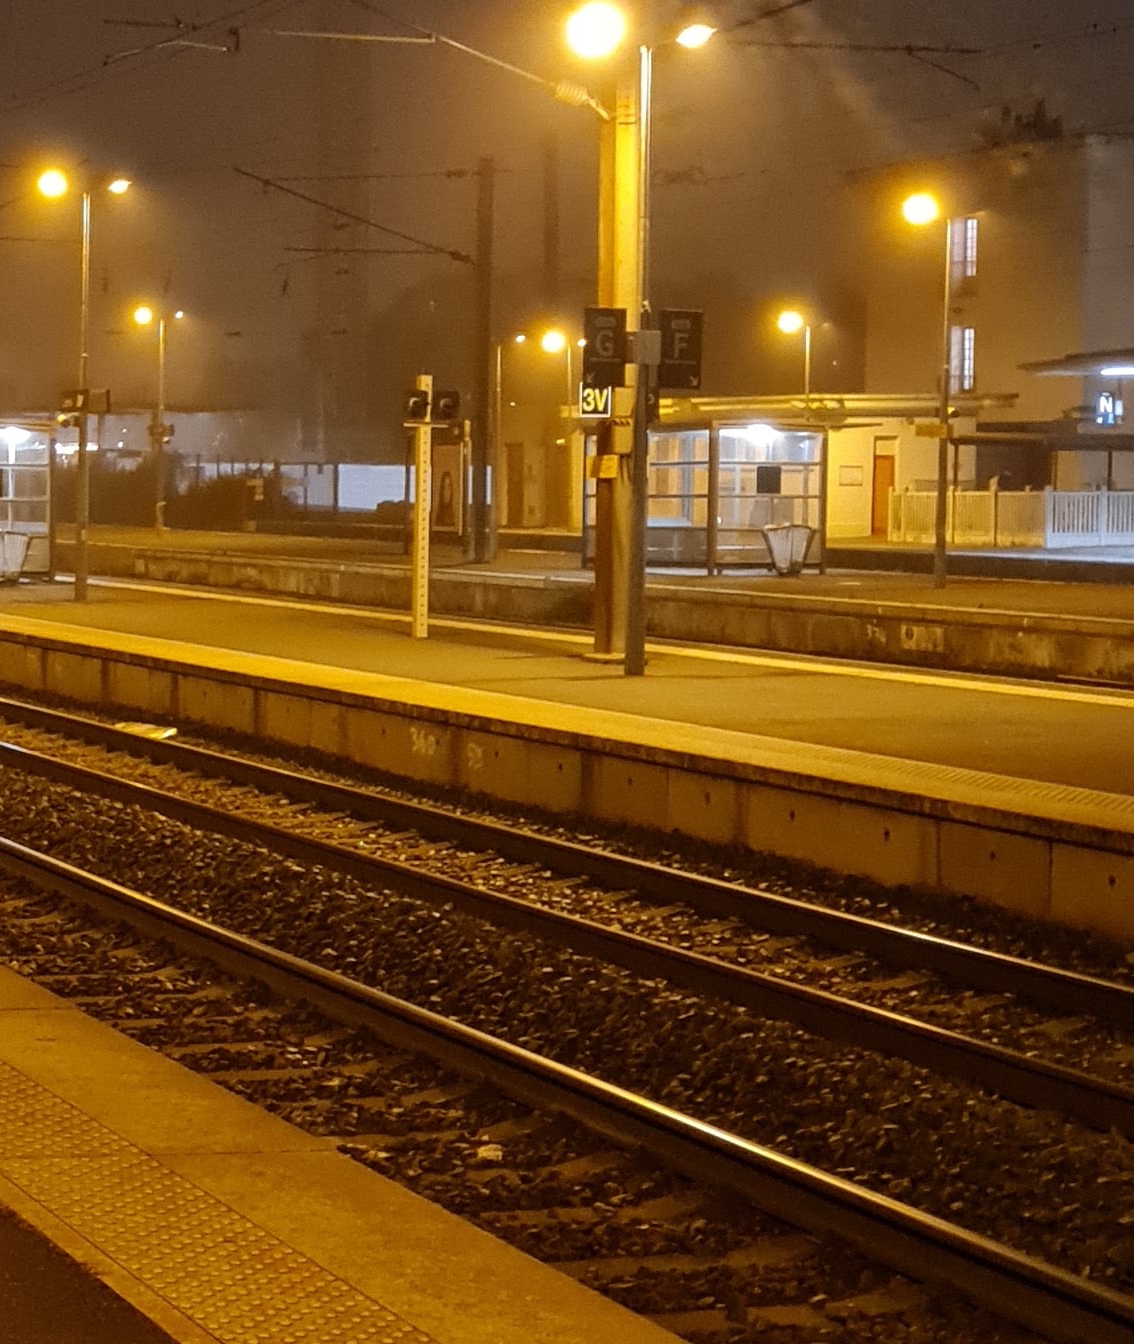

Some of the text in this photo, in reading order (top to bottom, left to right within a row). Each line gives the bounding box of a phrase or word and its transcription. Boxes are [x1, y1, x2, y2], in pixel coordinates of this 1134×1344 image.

[596, 329, 615, 357] G
[673, 332, 689, 359] F
[583, 388, 608, 412] 3V
[1099, 396, 1113, 413] N
